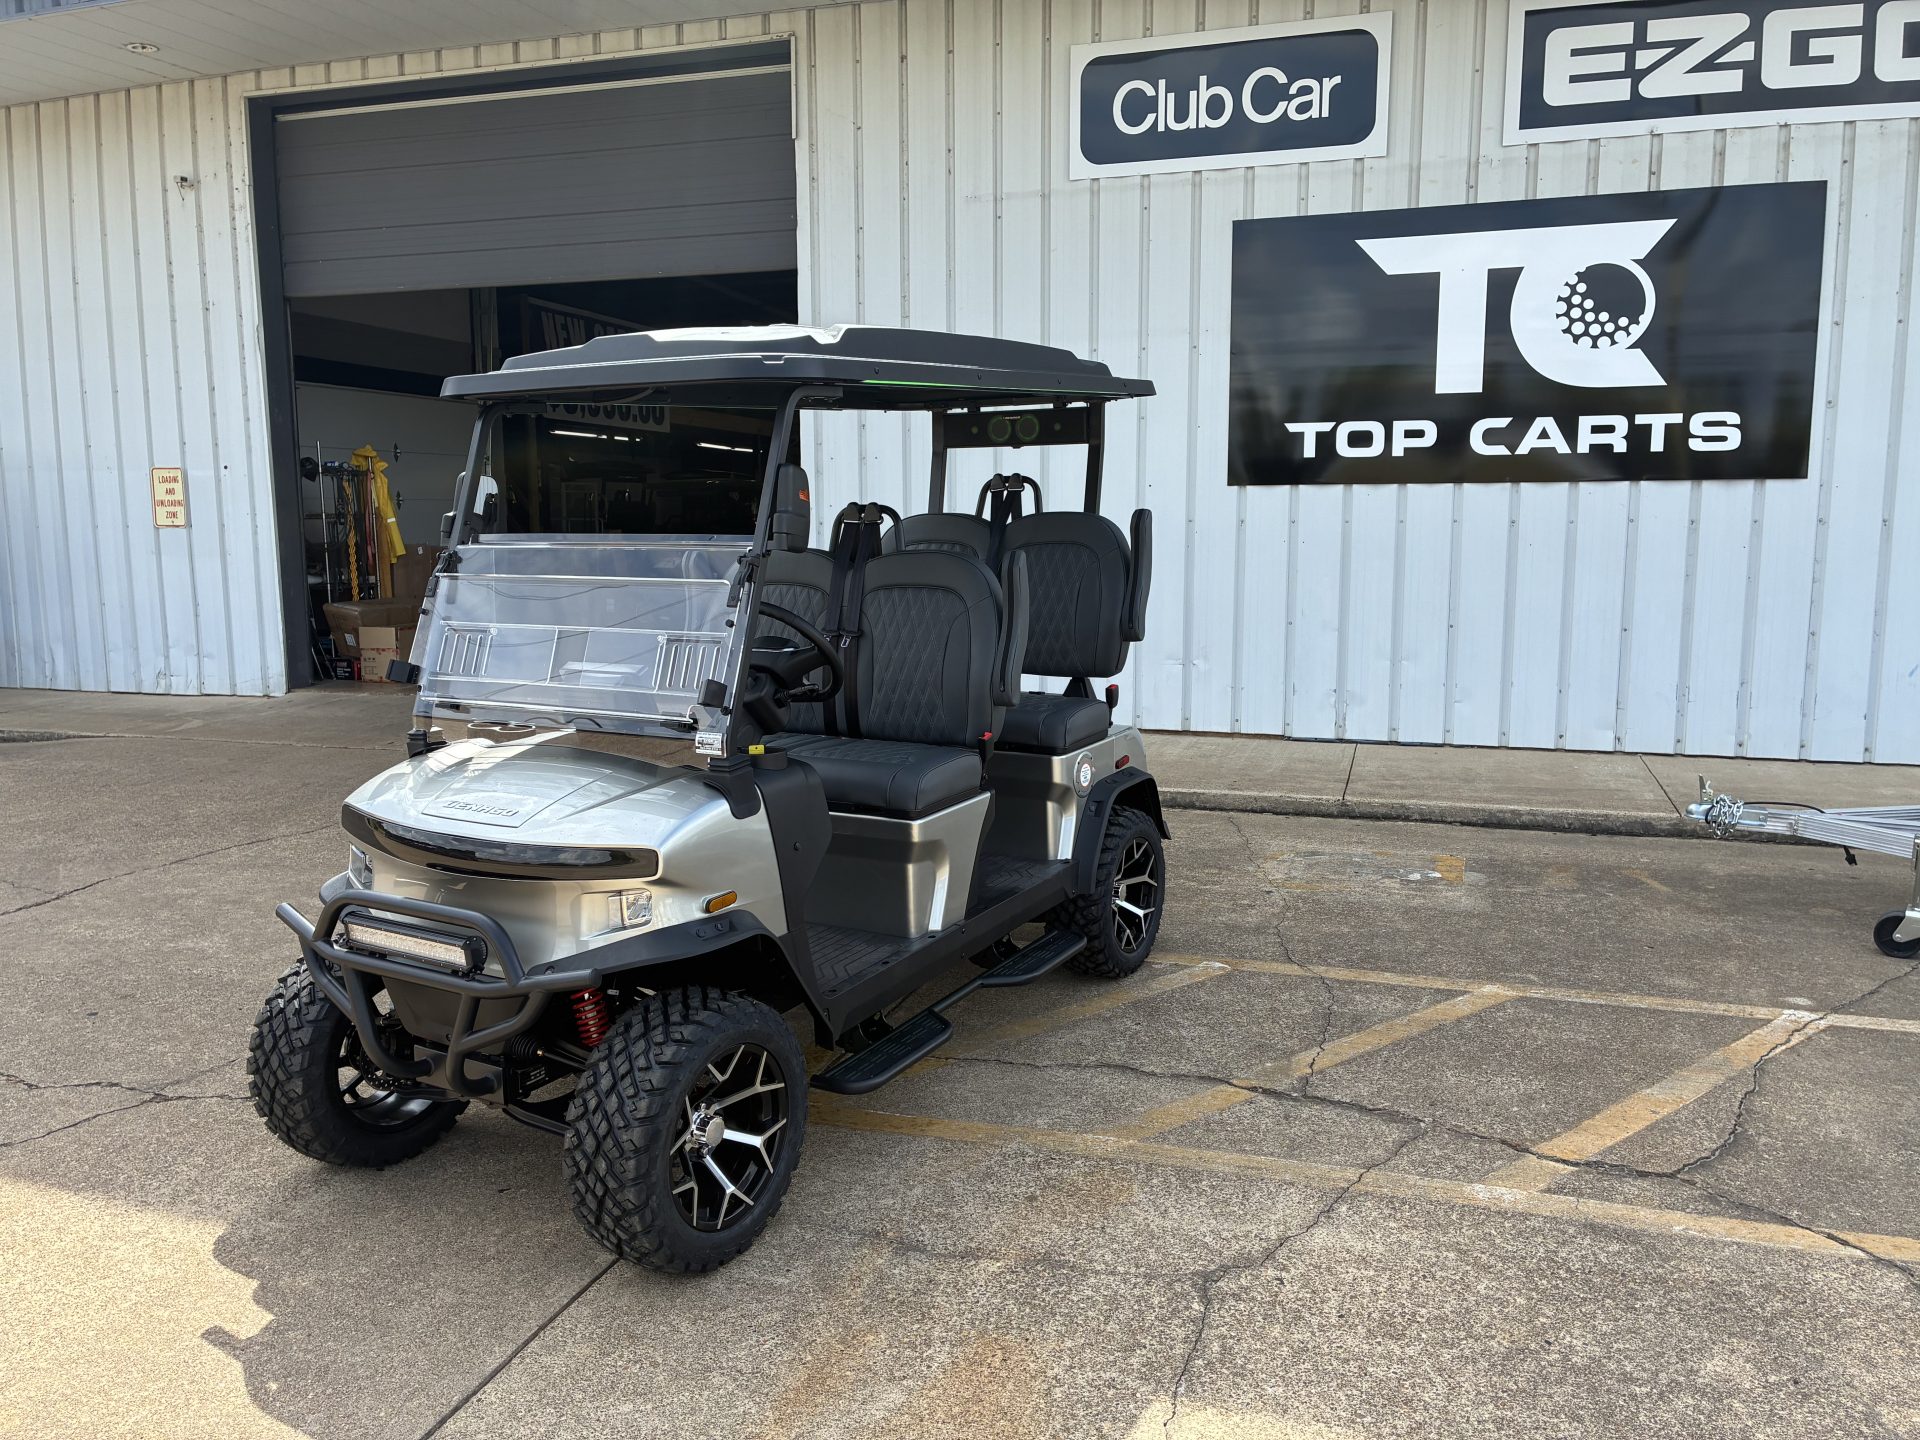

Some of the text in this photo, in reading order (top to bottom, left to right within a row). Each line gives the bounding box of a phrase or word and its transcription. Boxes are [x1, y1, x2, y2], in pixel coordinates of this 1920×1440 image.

[1112, 66, 1342, 135] Club Car
[541, 311, 586, 351] NEW
[1283, 411, 1742, 459] TOP CARTS
[158, 475, 179, 484] LOADING
[165, 487, 176, 495] AND
[156, 499, 183, 507] UNLOADING
[165, 510, 179, 519] ZONE
[443, 801, 519, 817] DENAGO
